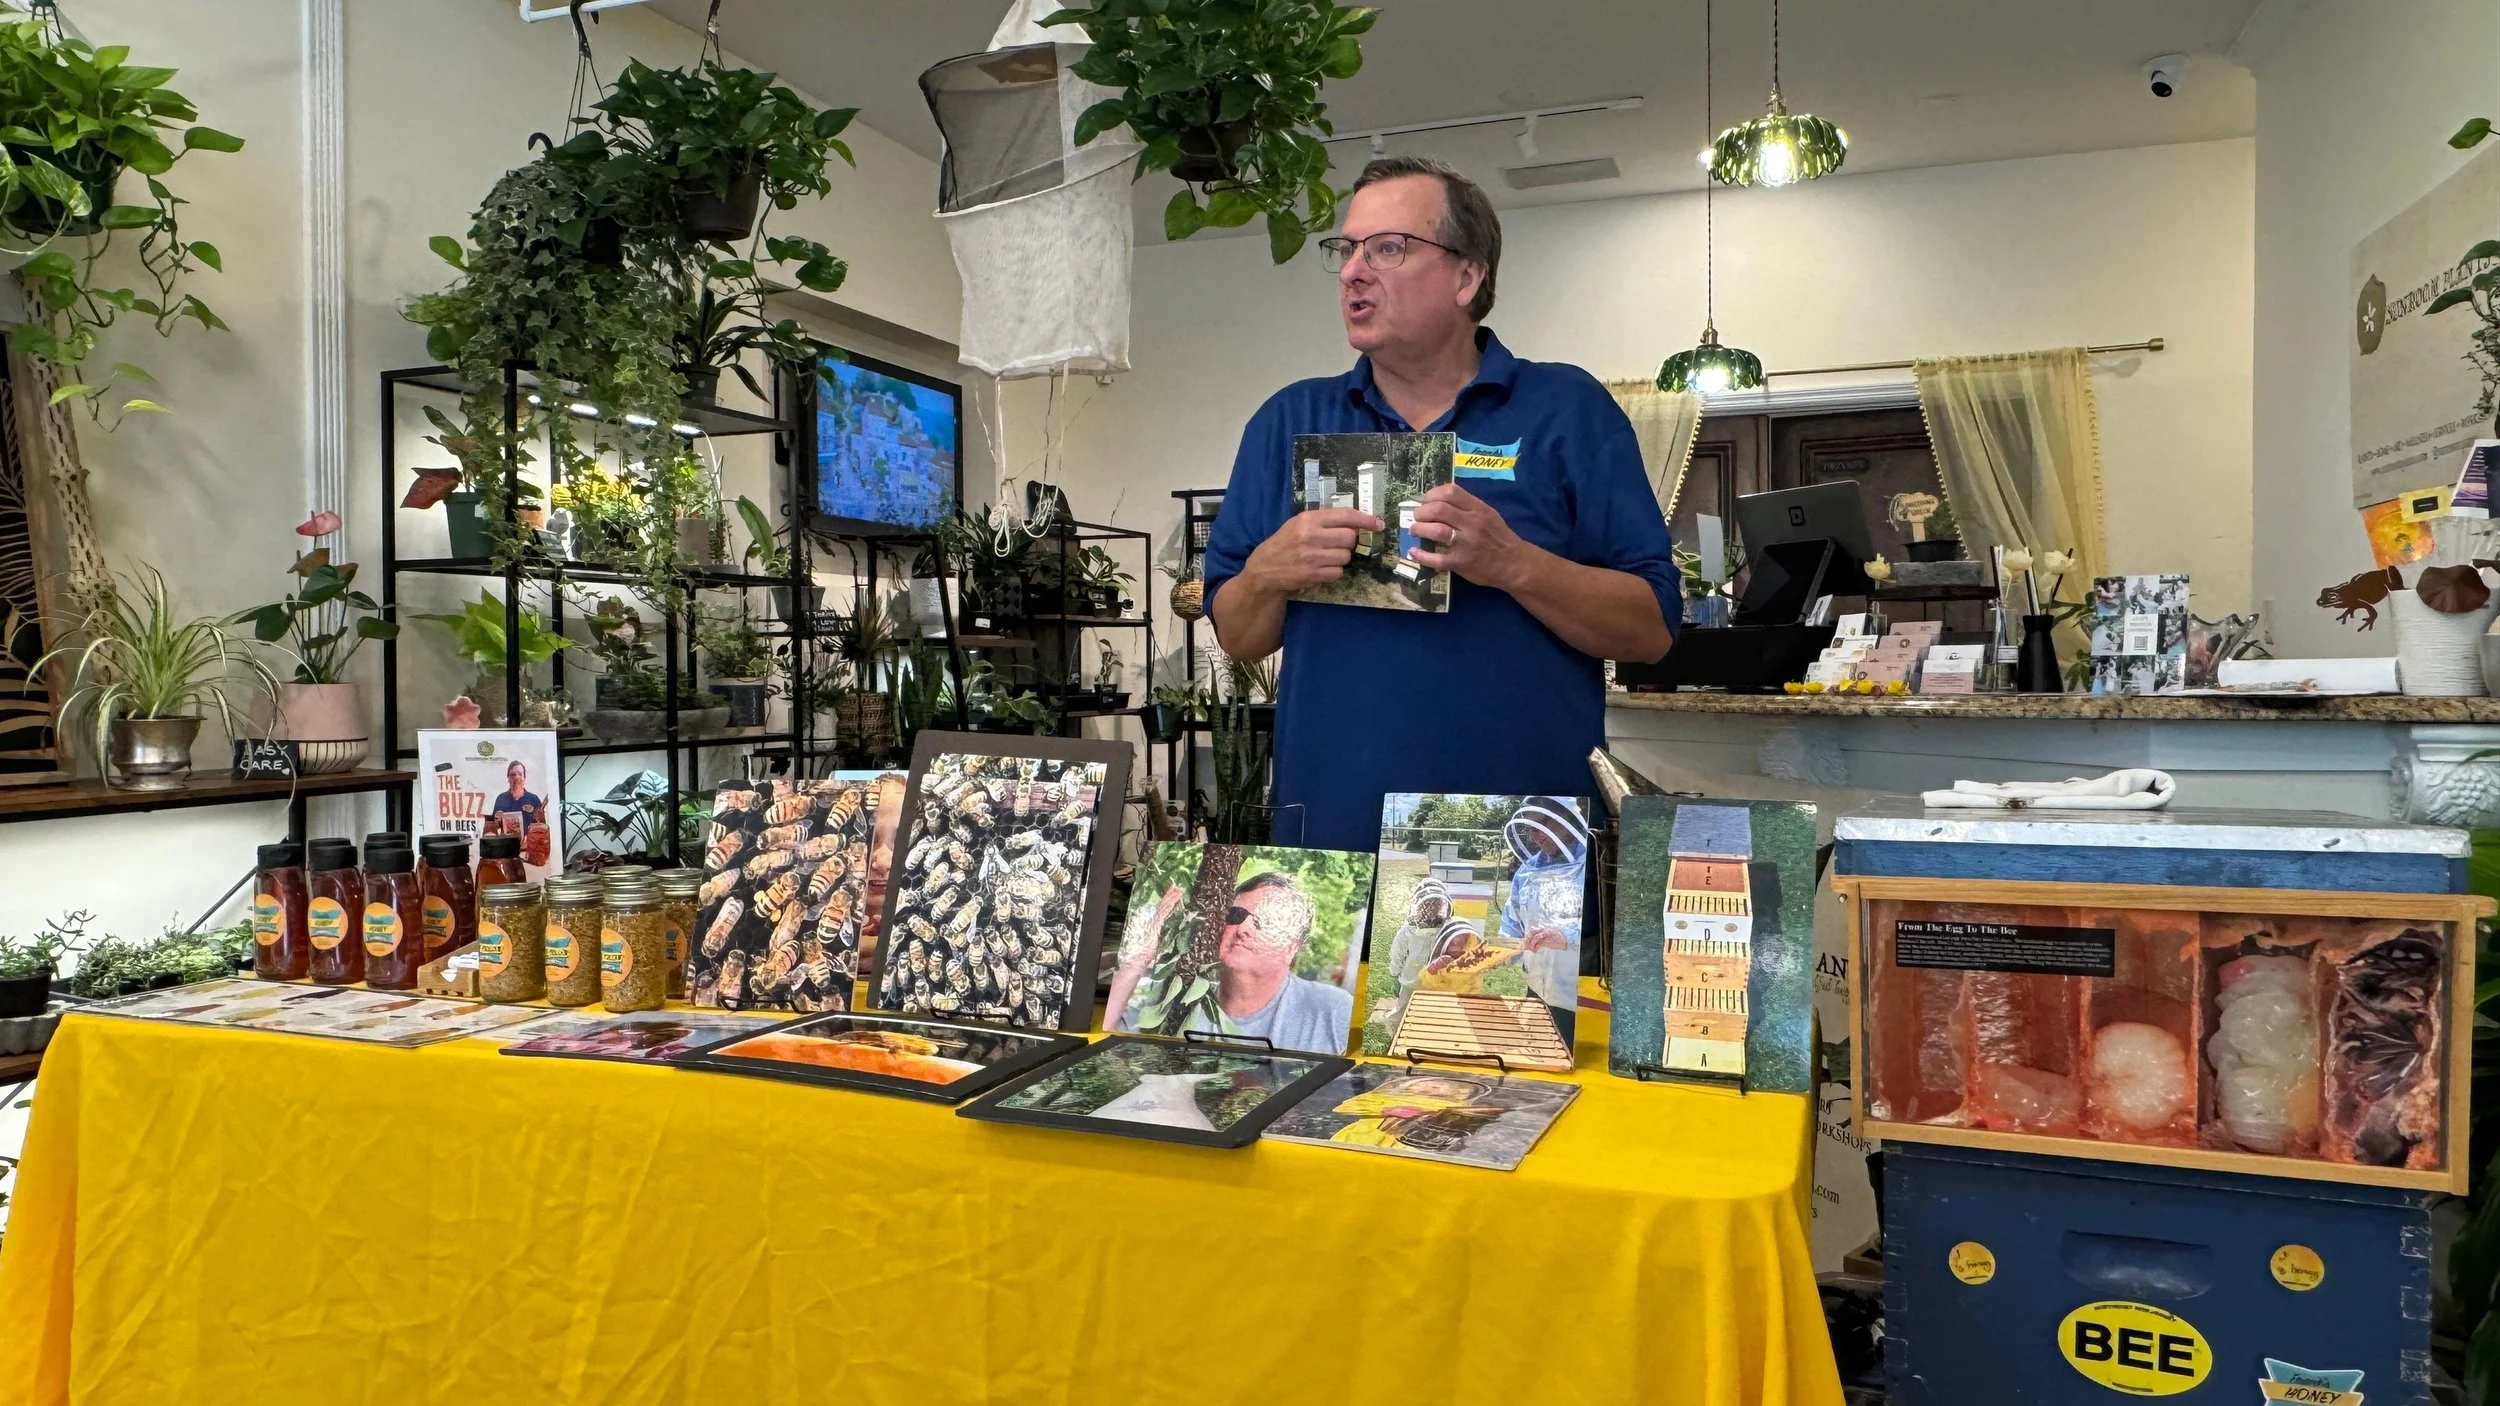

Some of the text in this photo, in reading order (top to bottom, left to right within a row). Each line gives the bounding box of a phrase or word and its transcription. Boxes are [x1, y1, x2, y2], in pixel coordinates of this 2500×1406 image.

[241, 744, 288, 756] ASY
[240, 760, 283, 771] CARE
[437, 775, 461, 790] THE
[439, 792, 485, 818] BUZZ
[1704, 928, 1710, 941] D
[1925, 923, 1943, 932] The
[1981, 925, 1998, 934] The
[1701, 972, 1708, 983] C
[2075, 1320, 2195, 1377] BEE
[2284, 1386, 2341, 1404] HONEY
